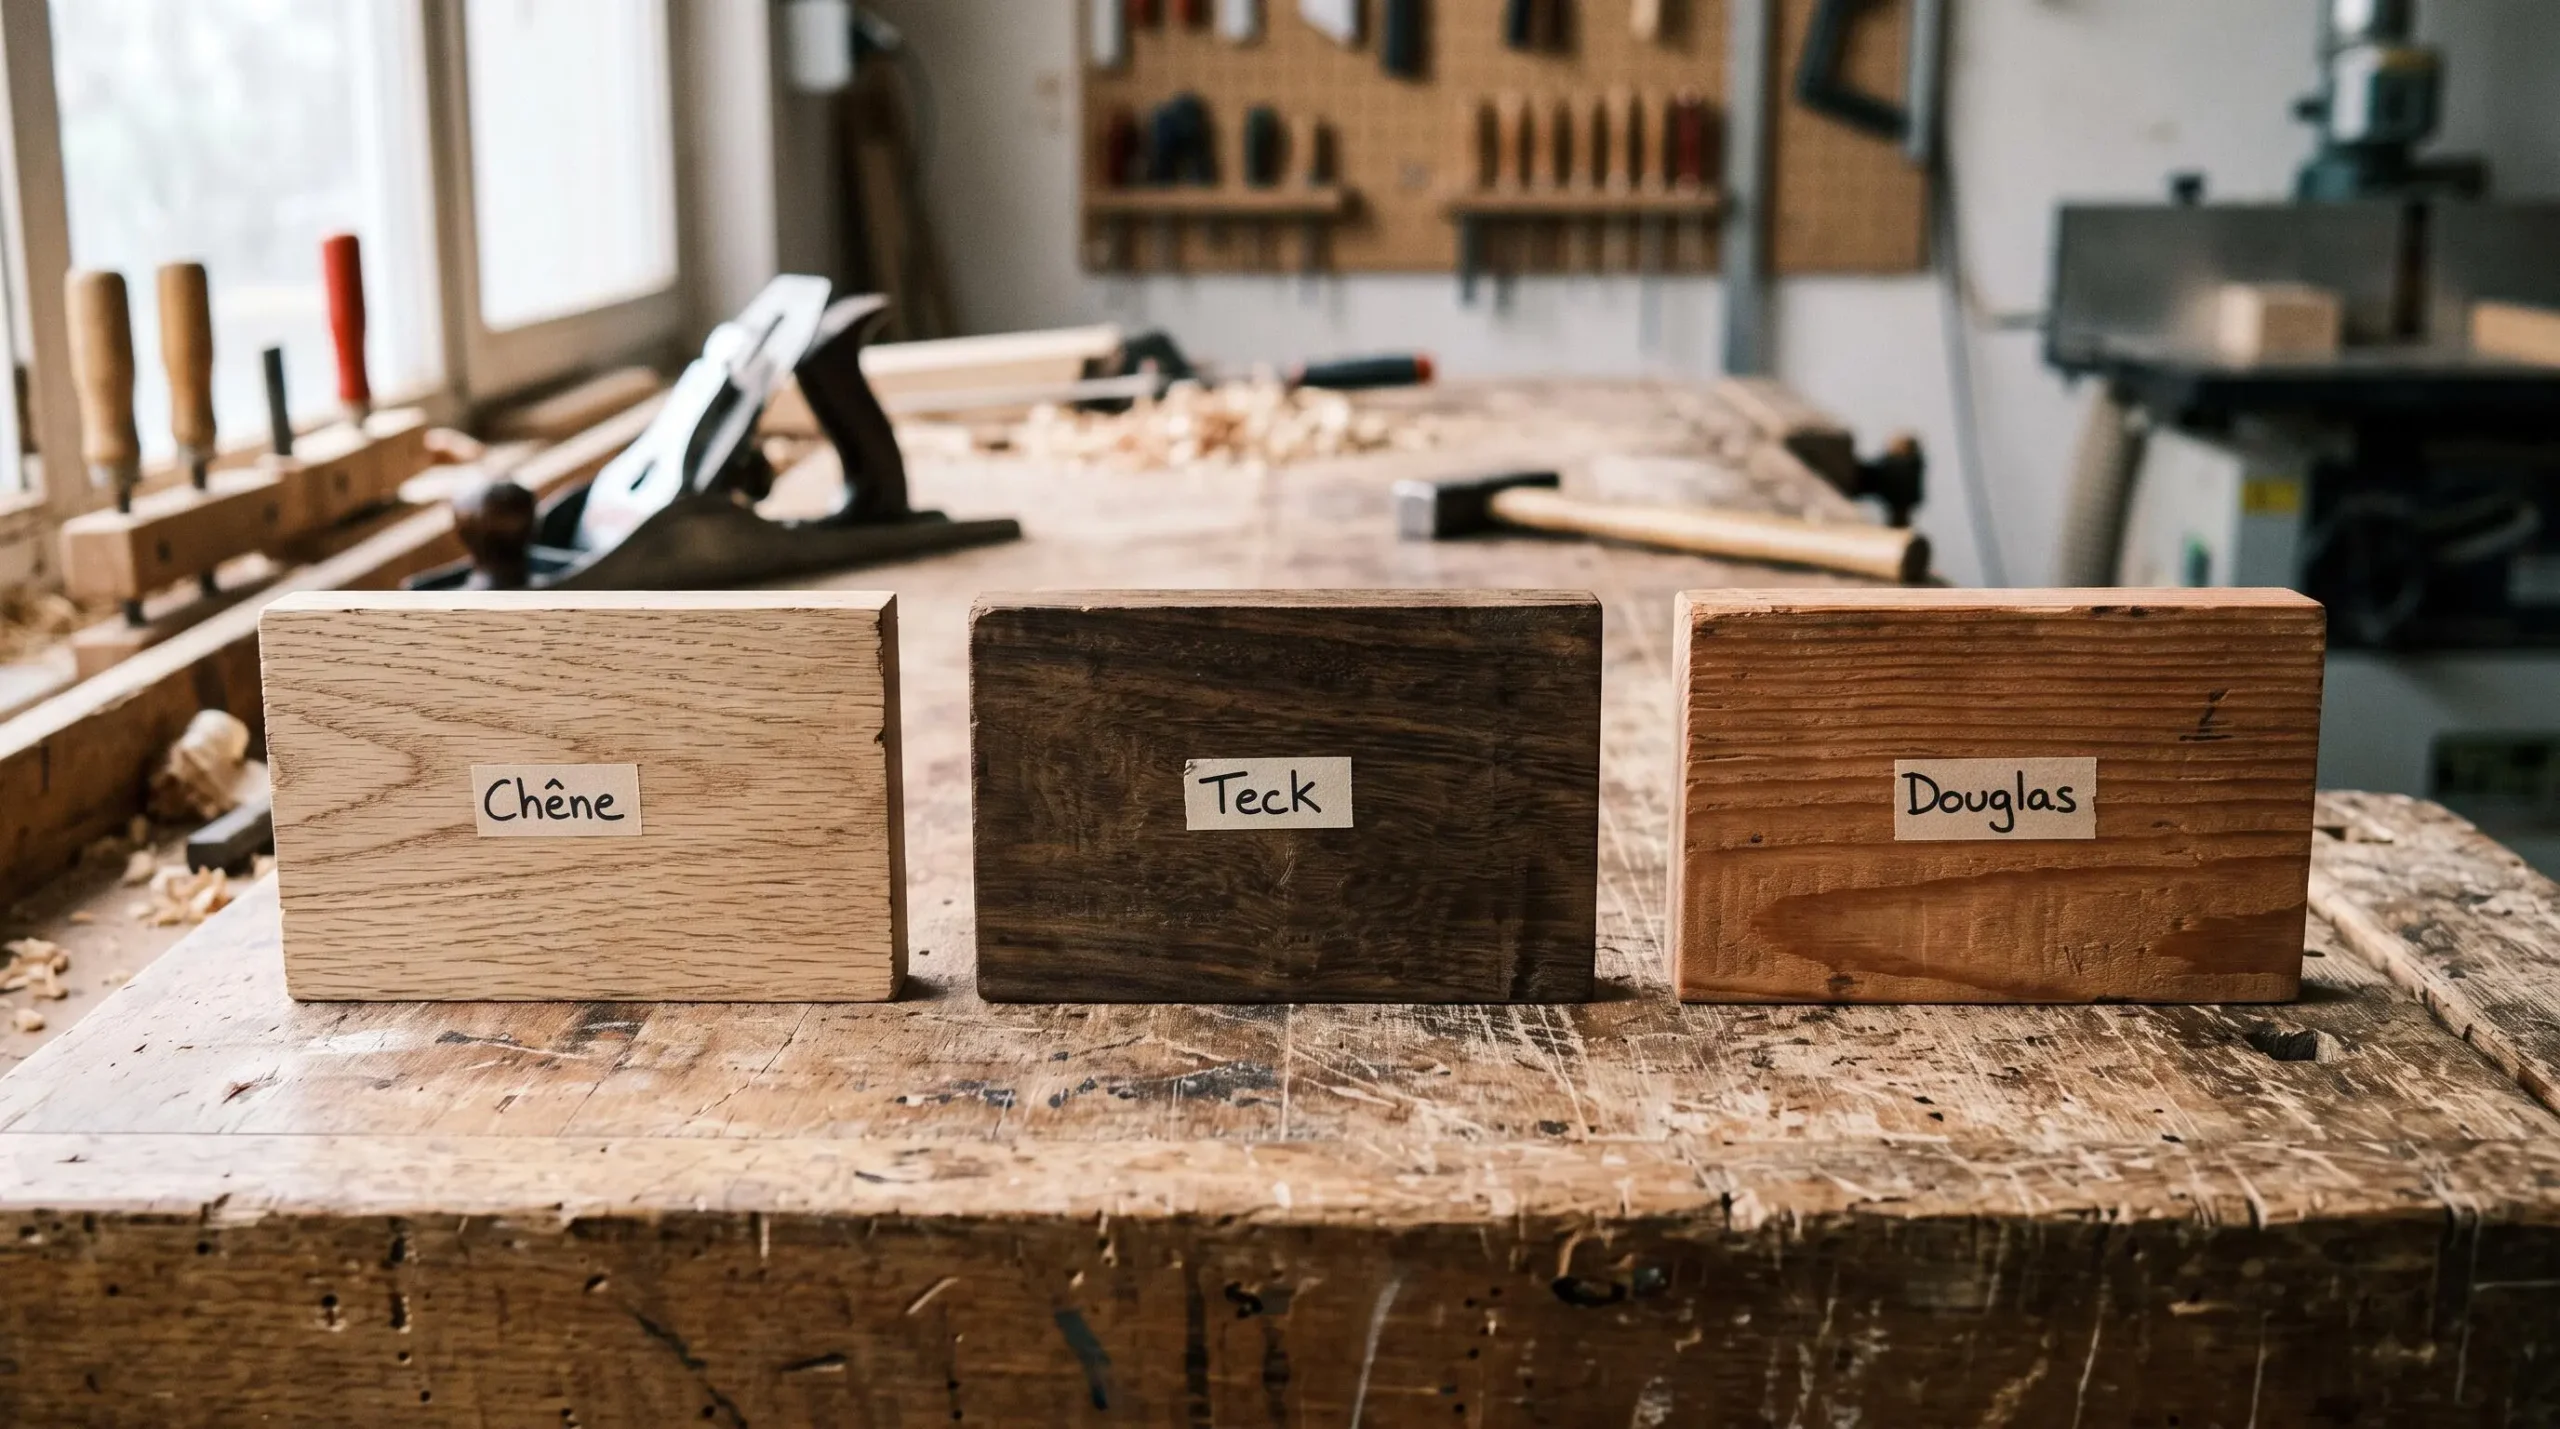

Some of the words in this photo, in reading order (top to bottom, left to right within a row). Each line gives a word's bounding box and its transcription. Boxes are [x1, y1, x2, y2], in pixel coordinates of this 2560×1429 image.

[484, 777, 625, 822] Chêne
[1198, 769, 1322, 815] Teck
[1901, 770, 2077, 834] Douglas
